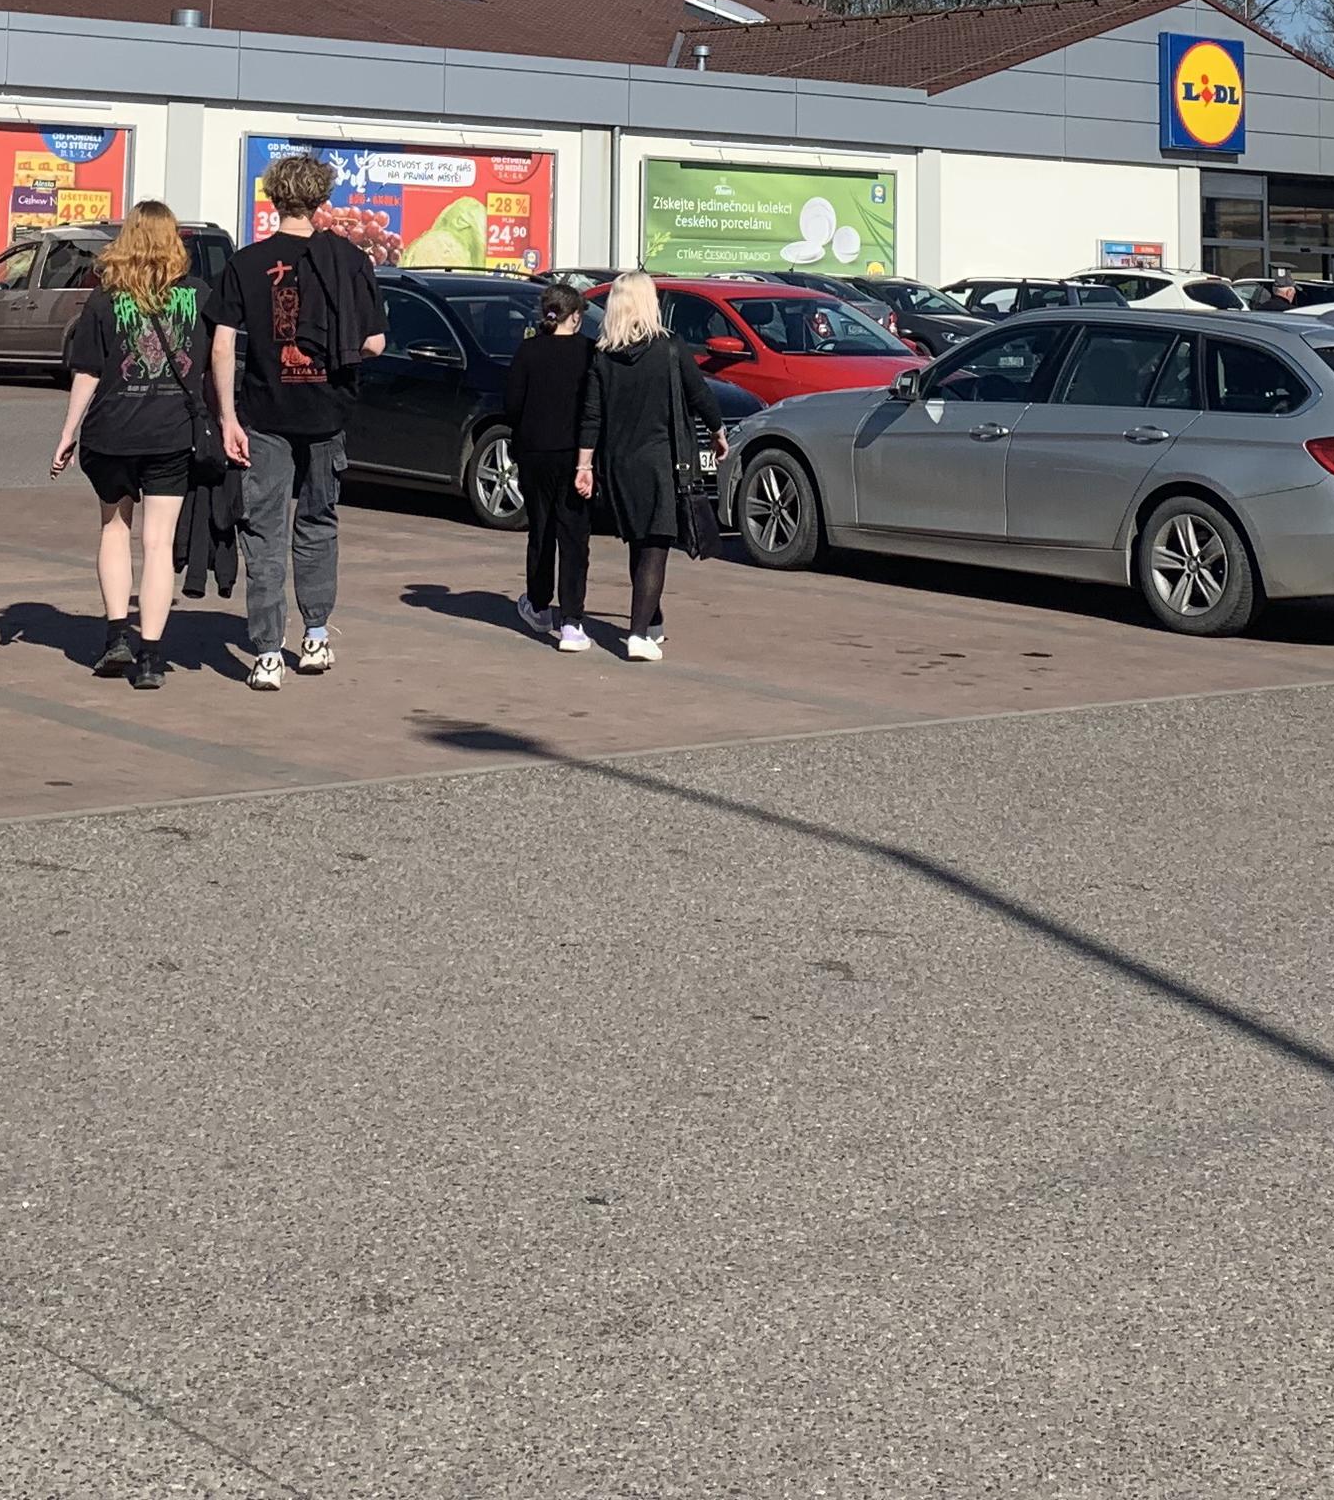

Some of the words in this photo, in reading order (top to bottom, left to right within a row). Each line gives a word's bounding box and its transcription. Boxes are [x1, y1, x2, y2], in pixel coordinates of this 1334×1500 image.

[56, 141, 67, 149] DO
[69, 141, 100, 150] STŘEDY
[377, 158, 421, 170] ČERSTVOST
[424, 161, 434, 171] JE
[438, 163, 453, 172] PRO
[456, 162, 472, 172] NÁS
[387, 171, 400, 180] NA
[404, 171, 434, 181] PRVNÍM
[18, 195, 47, 205] Cashew
[490, 197, 512, 213] -28
[515, 198, 527, 214] %
[653, 196, 694, 214] Získejte
[697, 199, 754, 214] jedinečnou
[757, 201, 792, 214] kolekci
[59, 204, 85, 220] 48
[91, 204, 107, 219] %
[257, 211, 280, 232] 39
[675, 215, 718, 228] českého
[721, 217, 772, 231] porcelánu
[677, 248, 703, 260] CTÍME
[704, 248, 737, 261] ČESKOU
